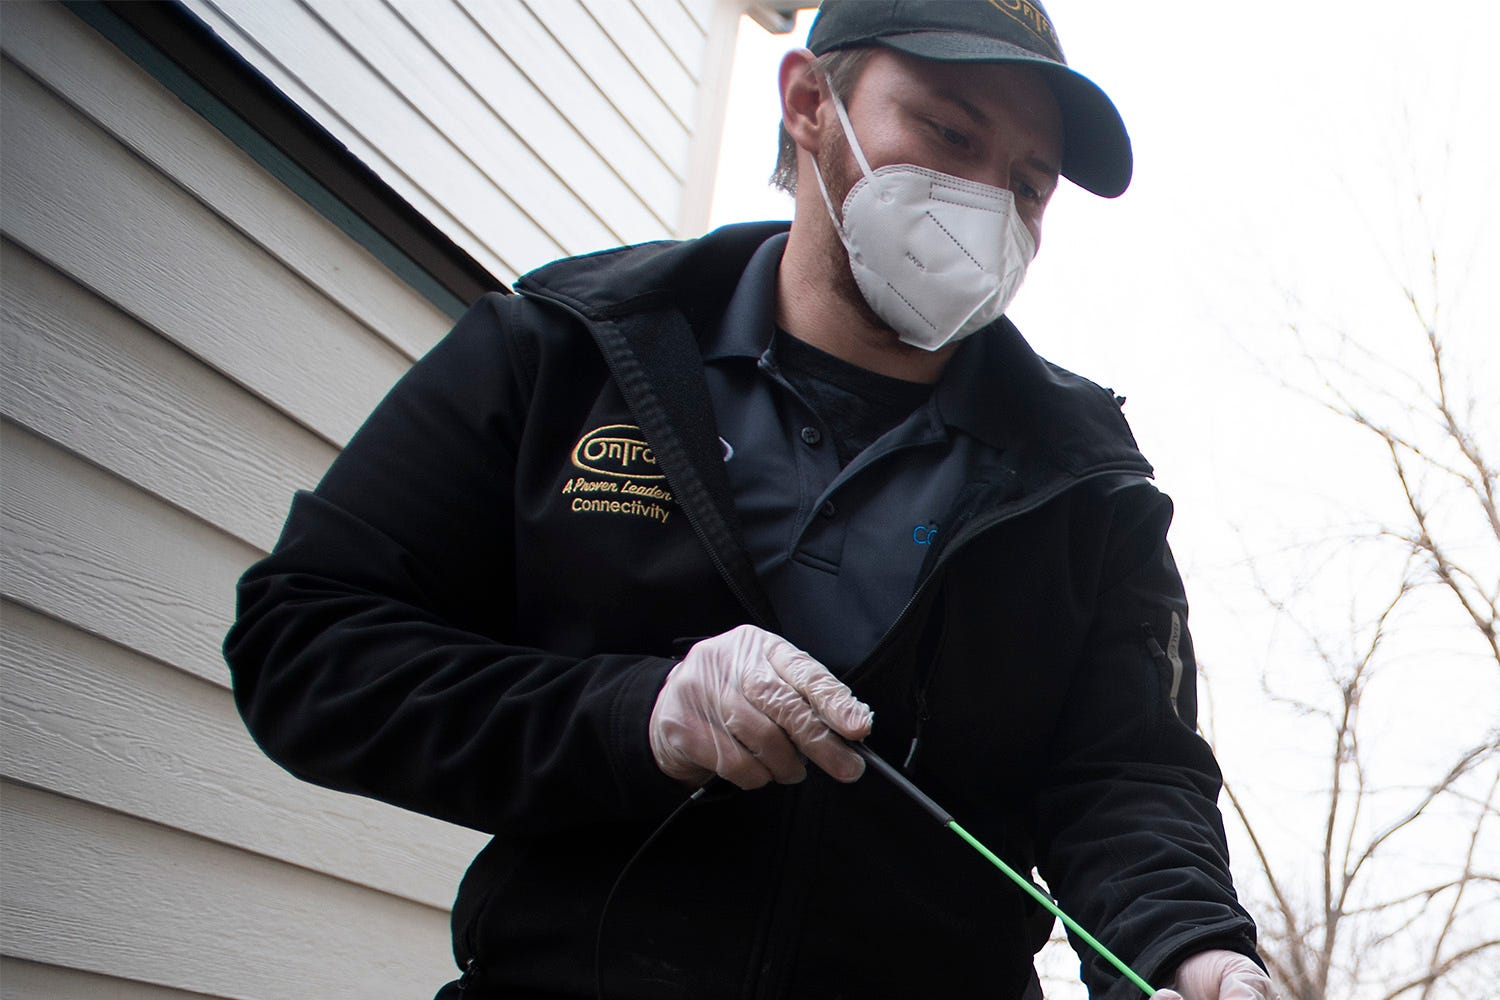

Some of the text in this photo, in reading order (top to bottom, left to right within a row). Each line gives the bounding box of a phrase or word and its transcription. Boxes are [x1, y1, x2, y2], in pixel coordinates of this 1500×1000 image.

[562, 479, 573, 494] A
[573, 478, 618, 493] Proven
[572, 498, 670, 523] Connectivity
